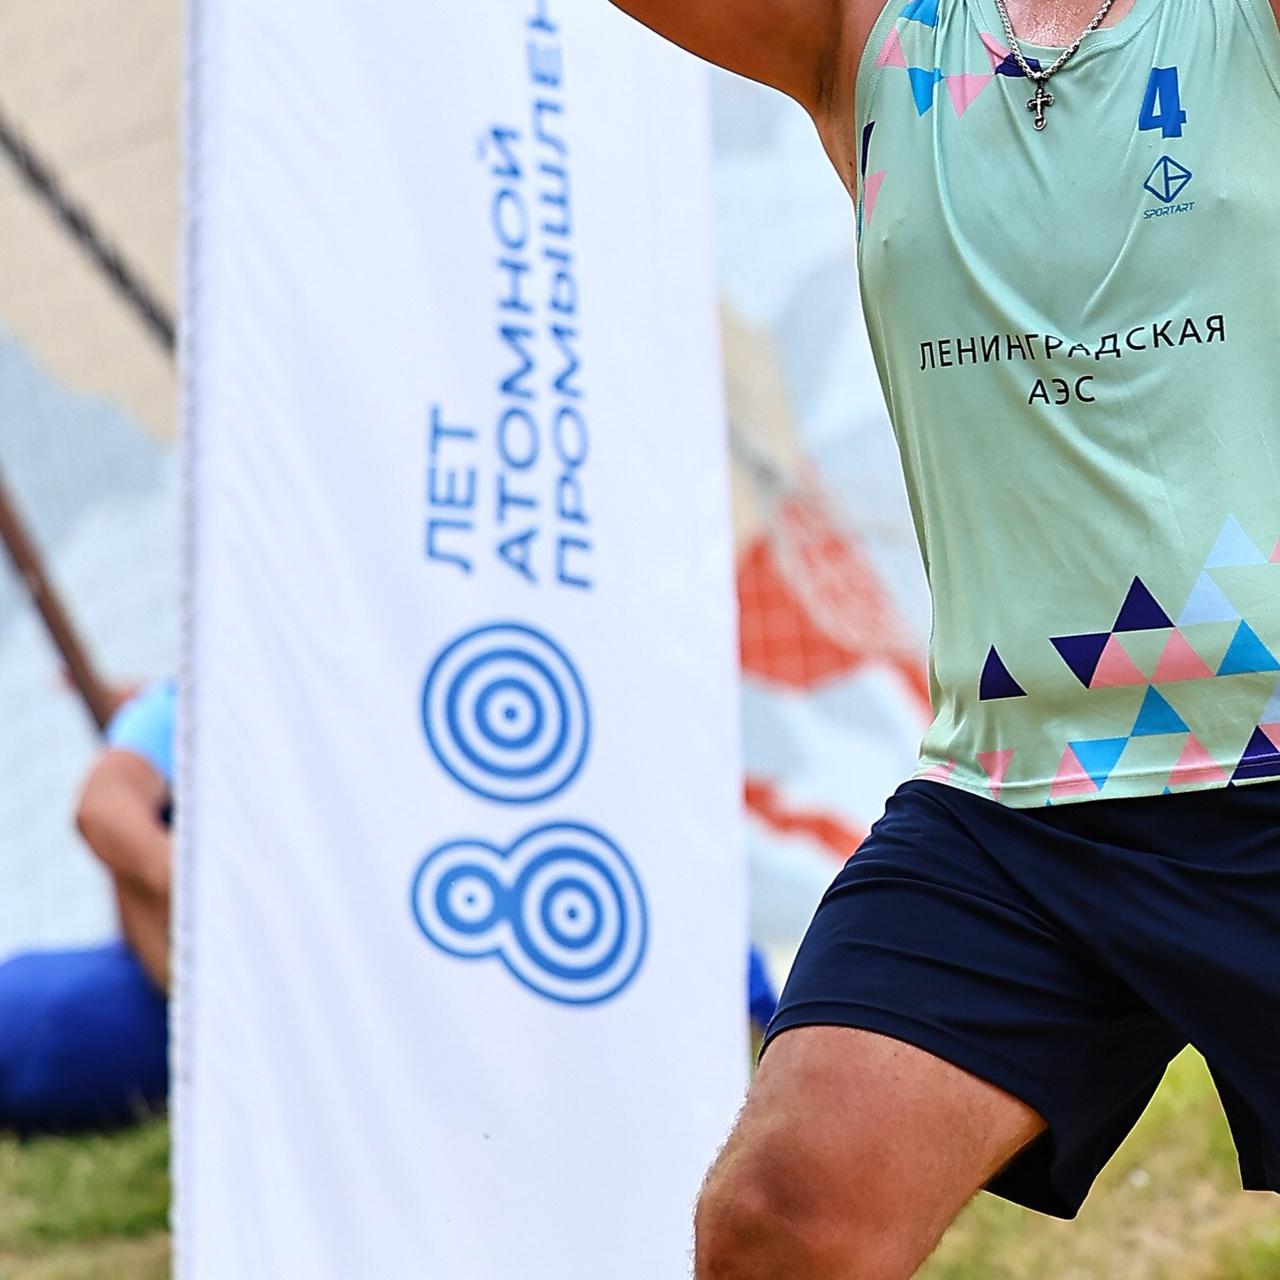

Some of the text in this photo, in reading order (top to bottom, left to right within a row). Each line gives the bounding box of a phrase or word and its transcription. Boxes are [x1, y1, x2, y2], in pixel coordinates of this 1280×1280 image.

[1138, 66, 1187, 139] 4
[1143, 201, 1196, 220] SPORTART
[477, 120, 541, 586] АТОМНОЙ
[919, 314, 1227, 371] ЛЕНИНГРАДСКАЯ
[1027, 375, 1096, 405] АЭС
[424, 405, 479, 576] ЛЕТ
